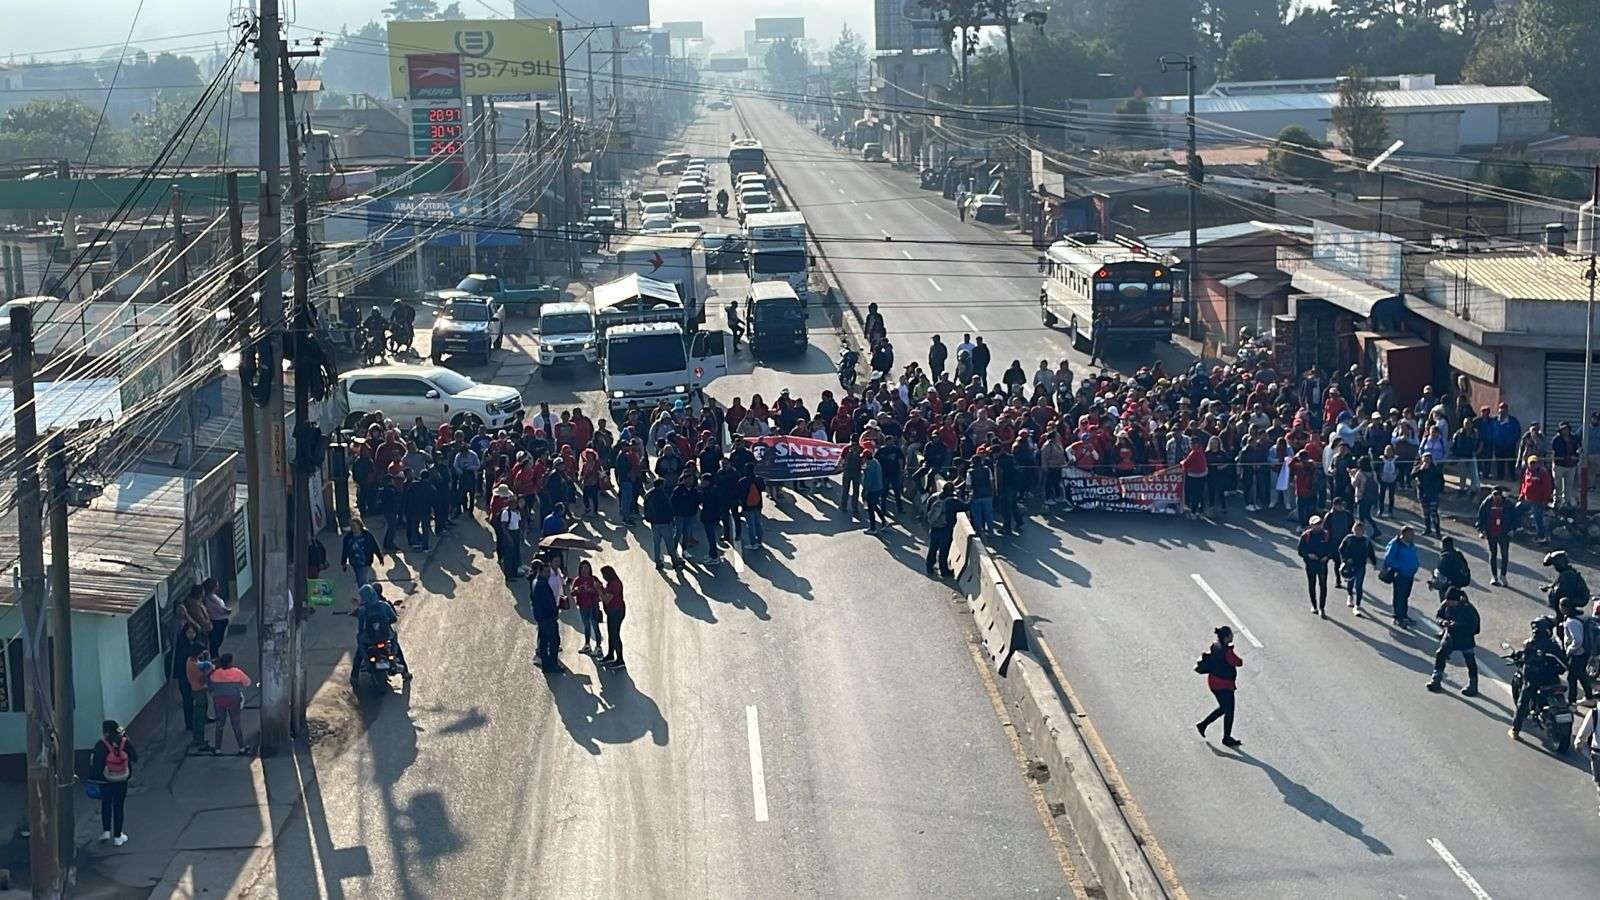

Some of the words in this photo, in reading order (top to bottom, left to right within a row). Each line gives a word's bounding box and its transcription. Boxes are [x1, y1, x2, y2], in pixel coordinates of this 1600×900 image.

[1063, 479, 1085, 488] POR
[1086, 479, 1099, 487] LA
[1163, 474, 1183, 483] LOS
[1171, 483, 1178, 492] Y
